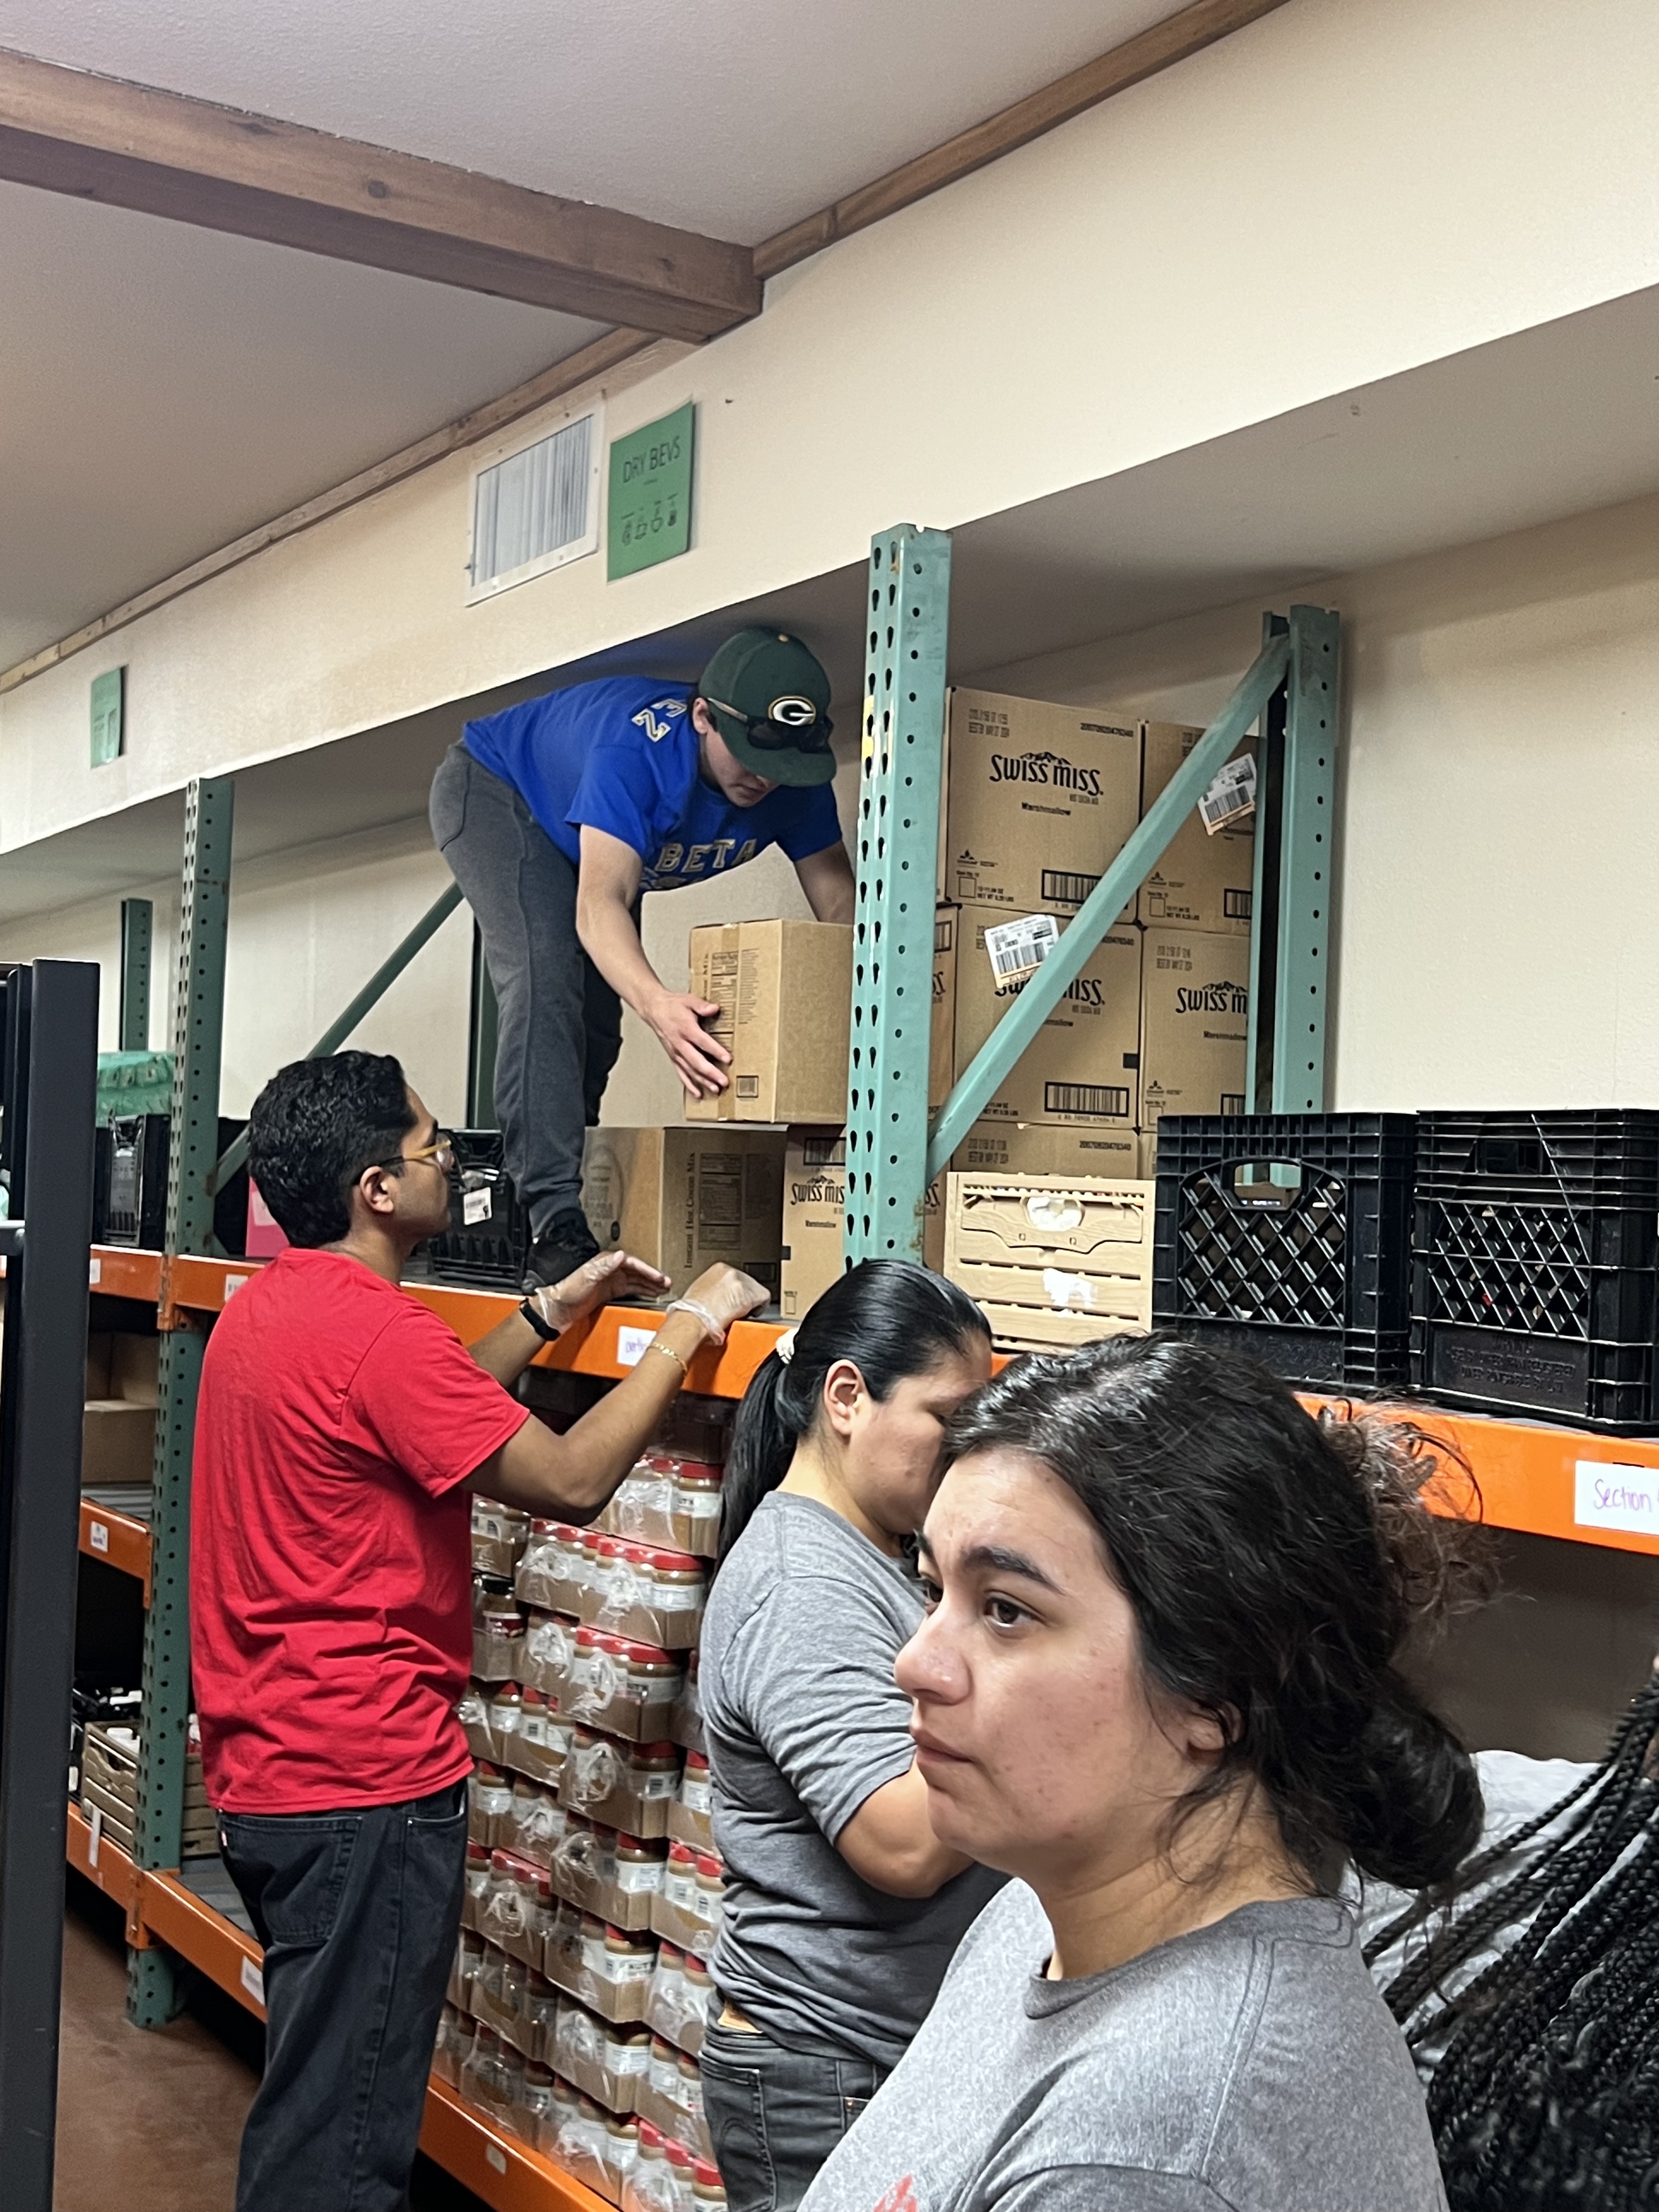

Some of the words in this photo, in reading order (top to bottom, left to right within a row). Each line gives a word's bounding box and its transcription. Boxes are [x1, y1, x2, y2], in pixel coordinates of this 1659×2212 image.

[650, 436, 680, 471] BEVS
[769, 696, 816, 725] G
[989, 754, 1048, 783] SWISS
[1053, 764, 1104, 796] MISS
[655, 838, 757, 872] BETA
[1175, 988, 1228, 1013] SWISS
[790, 1182, 823, 1205] SWISS
[825, 1185, 845, 1205] MIS
[1593, 1479, 1652, 1513] Section
